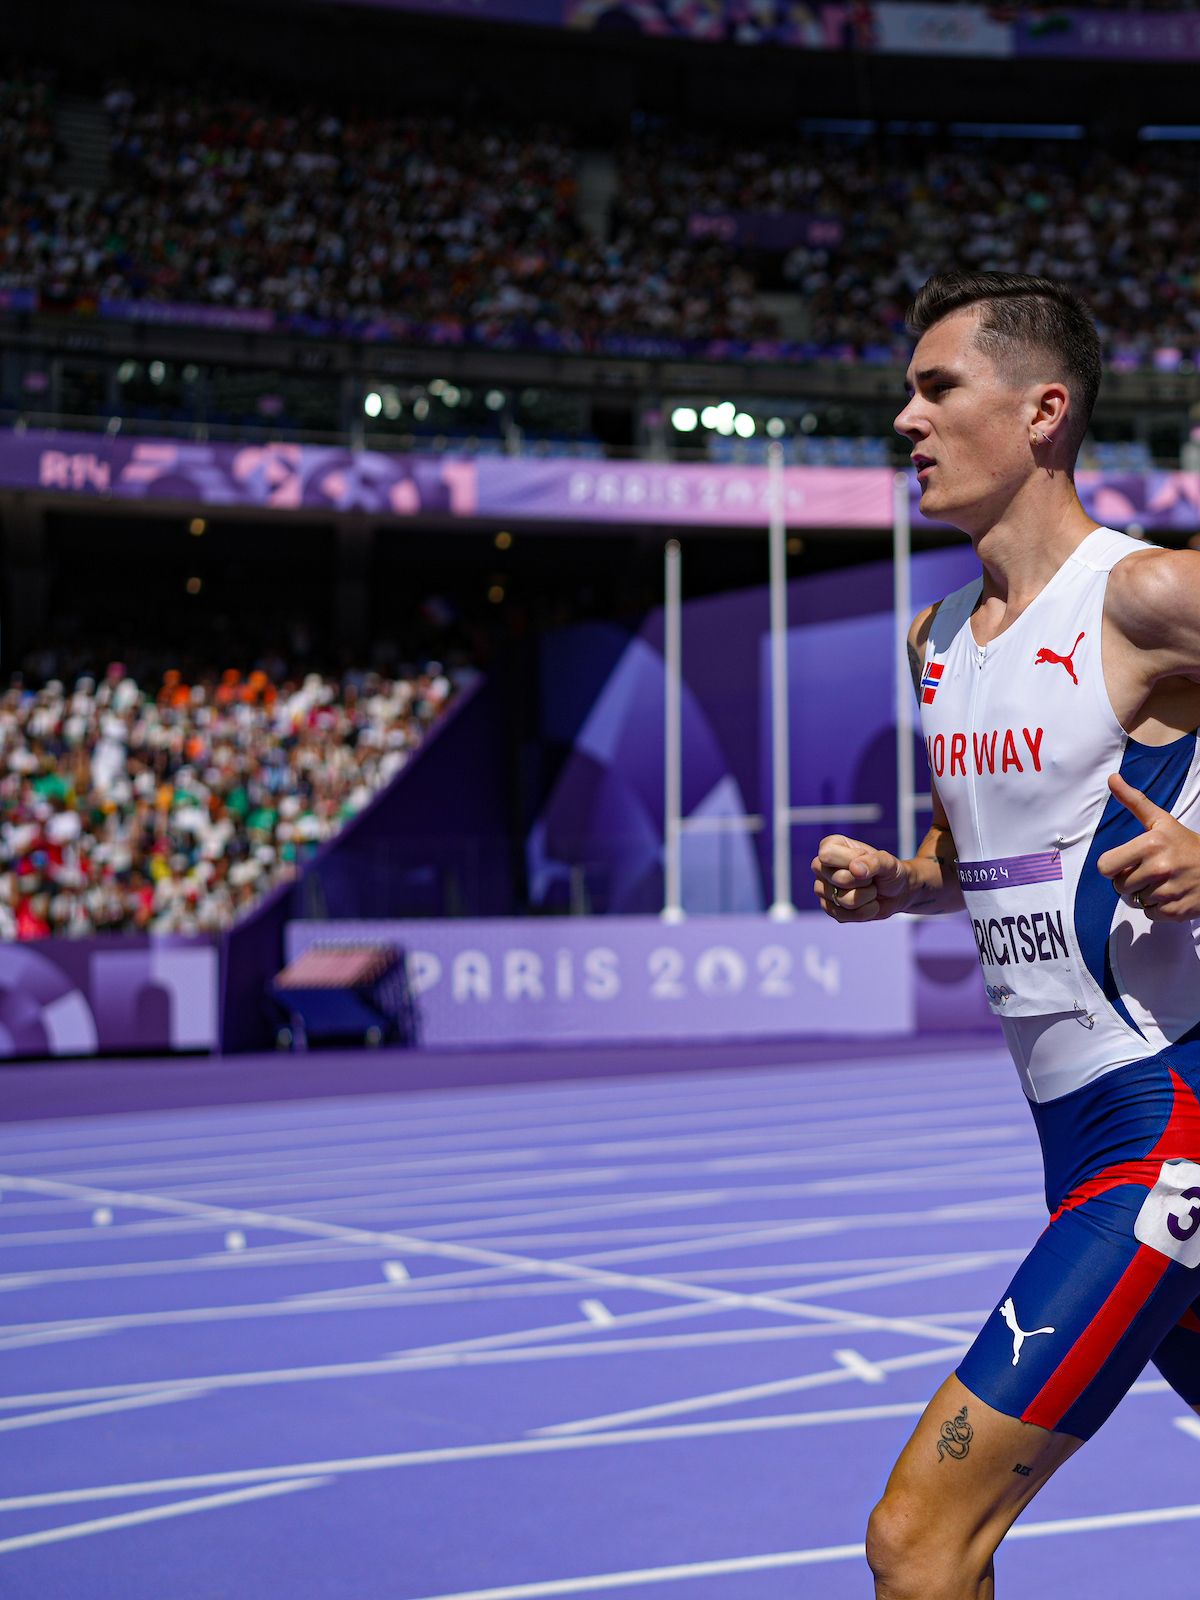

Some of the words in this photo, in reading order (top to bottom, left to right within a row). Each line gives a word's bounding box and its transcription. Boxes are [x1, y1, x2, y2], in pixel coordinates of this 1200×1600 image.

[39, 450, 110, 492] R14
[974, 866, 1009, 882] 2024
[971, 910, 1070, 967] RIGTSEN
[647, 944, 842, 998] 2024
